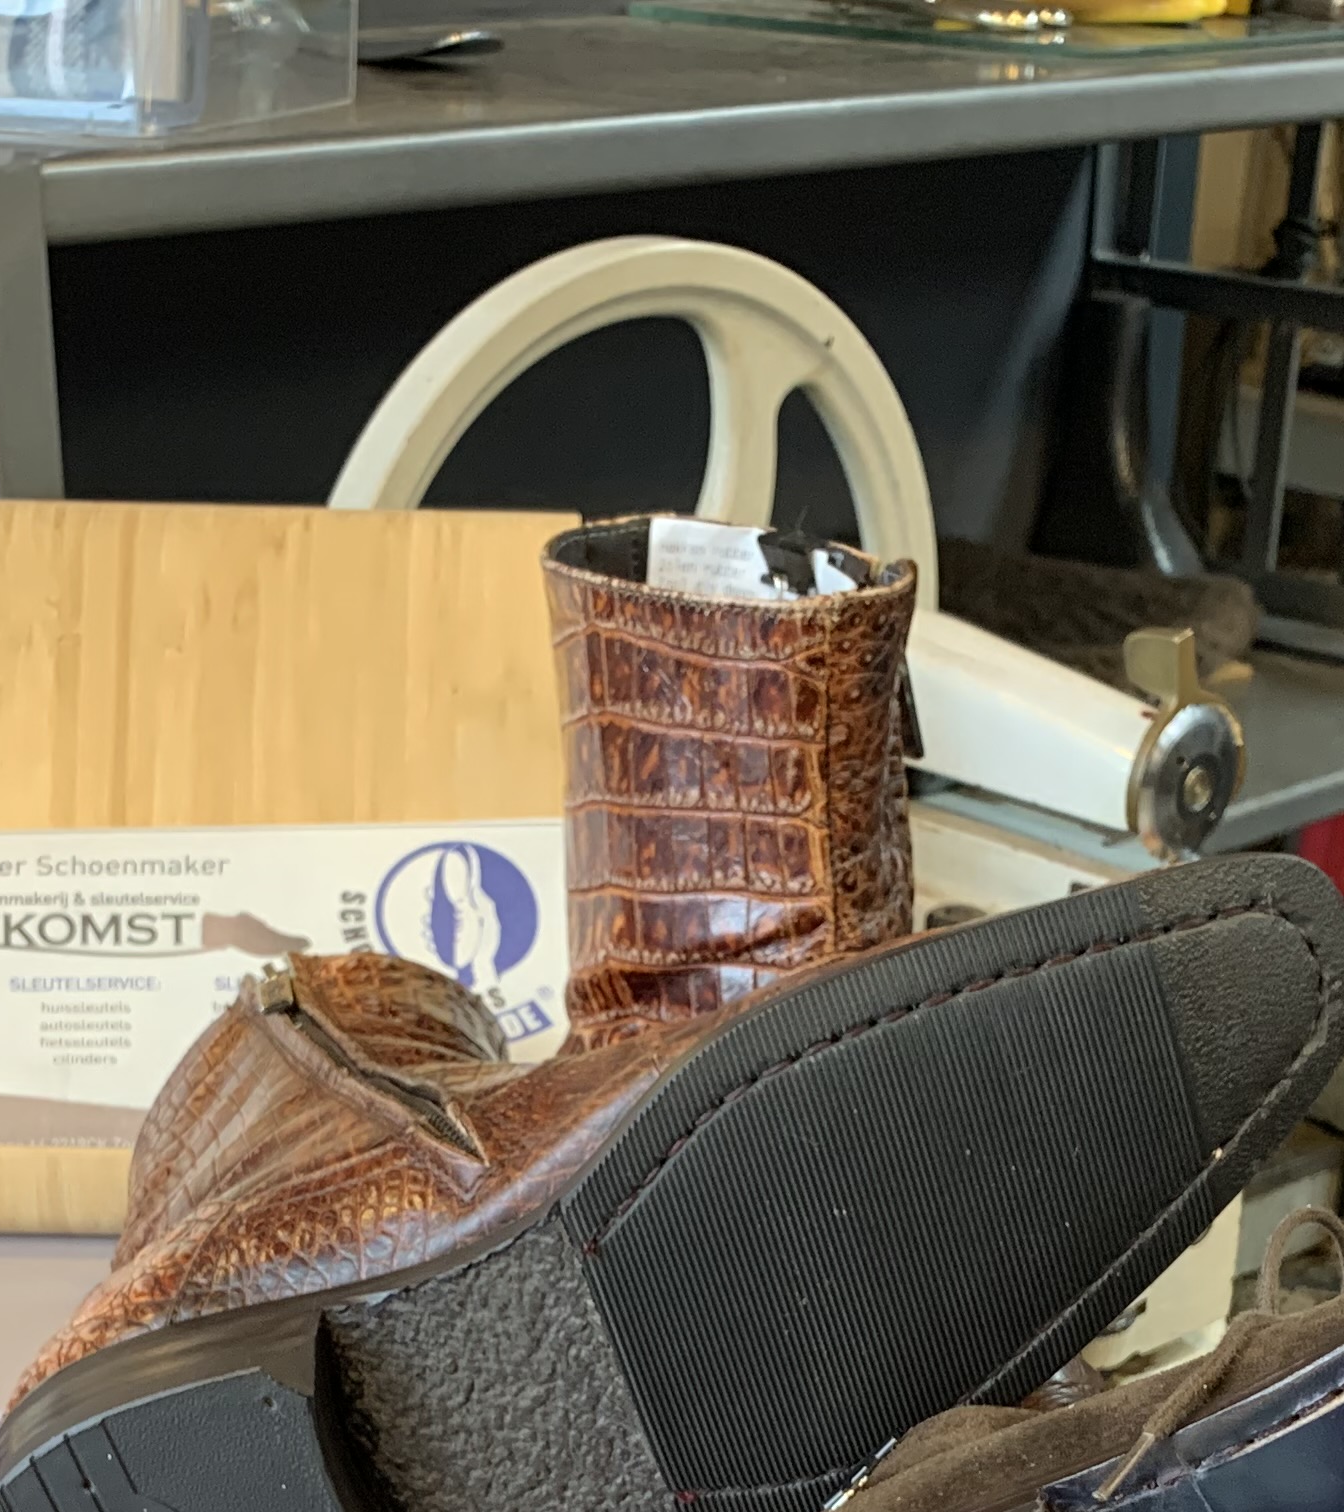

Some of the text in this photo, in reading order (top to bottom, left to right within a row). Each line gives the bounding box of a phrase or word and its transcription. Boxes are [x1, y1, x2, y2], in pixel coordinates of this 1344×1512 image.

[36, 855, 230, 877] Schoenmaker
[73, 893, 86, 906] &
[90, 892, 201, 907] sleutelservice
